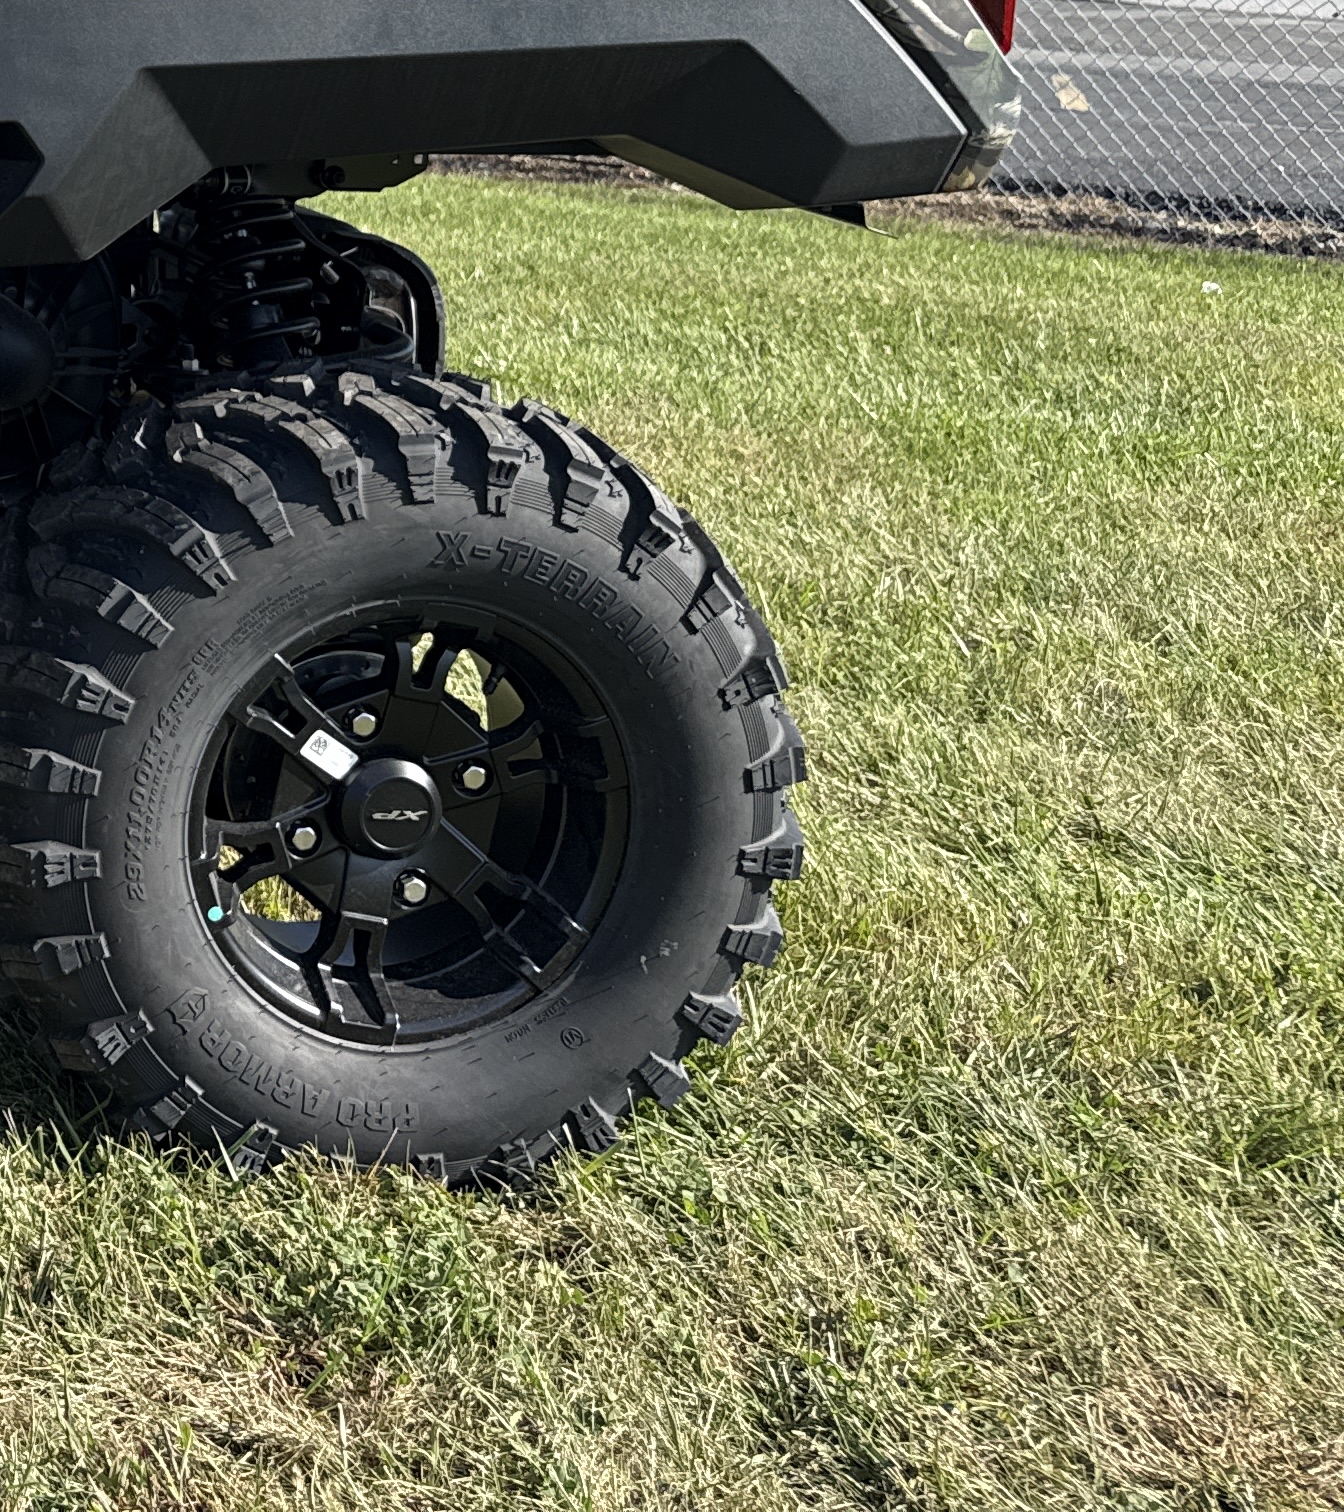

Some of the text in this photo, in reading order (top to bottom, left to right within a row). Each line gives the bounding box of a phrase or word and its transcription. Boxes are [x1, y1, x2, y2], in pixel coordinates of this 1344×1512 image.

[430, 530, 680, 679] X-TERRAIN
[371, 809, 429, 822] XP
[198, 1018, 420, 1134] PRO ARMOR
